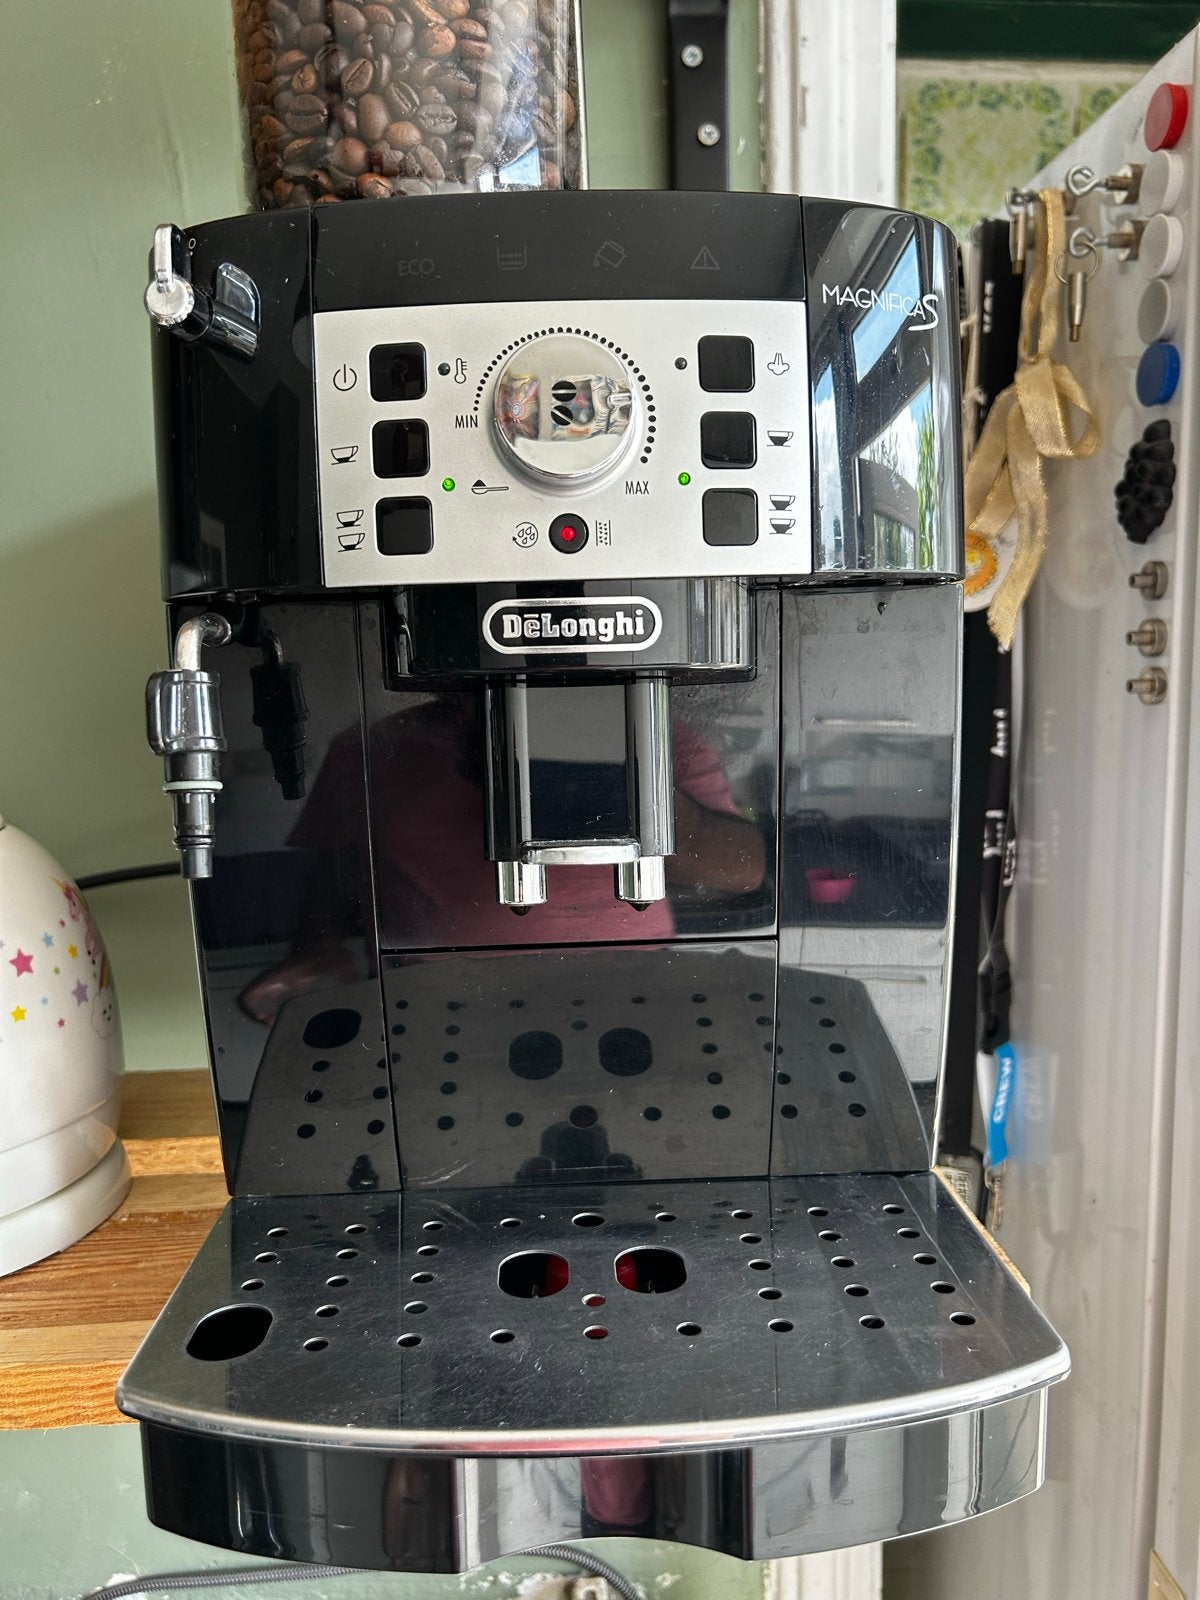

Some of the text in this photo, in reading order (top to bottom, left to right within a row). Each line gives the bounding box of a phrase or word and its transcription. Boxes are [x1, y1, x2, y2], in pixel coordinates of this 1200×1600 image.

[398, 258, 435, 276] ECO
[455, 415, 478, 429] MIN
[625, 481, 650, 495] MAX
